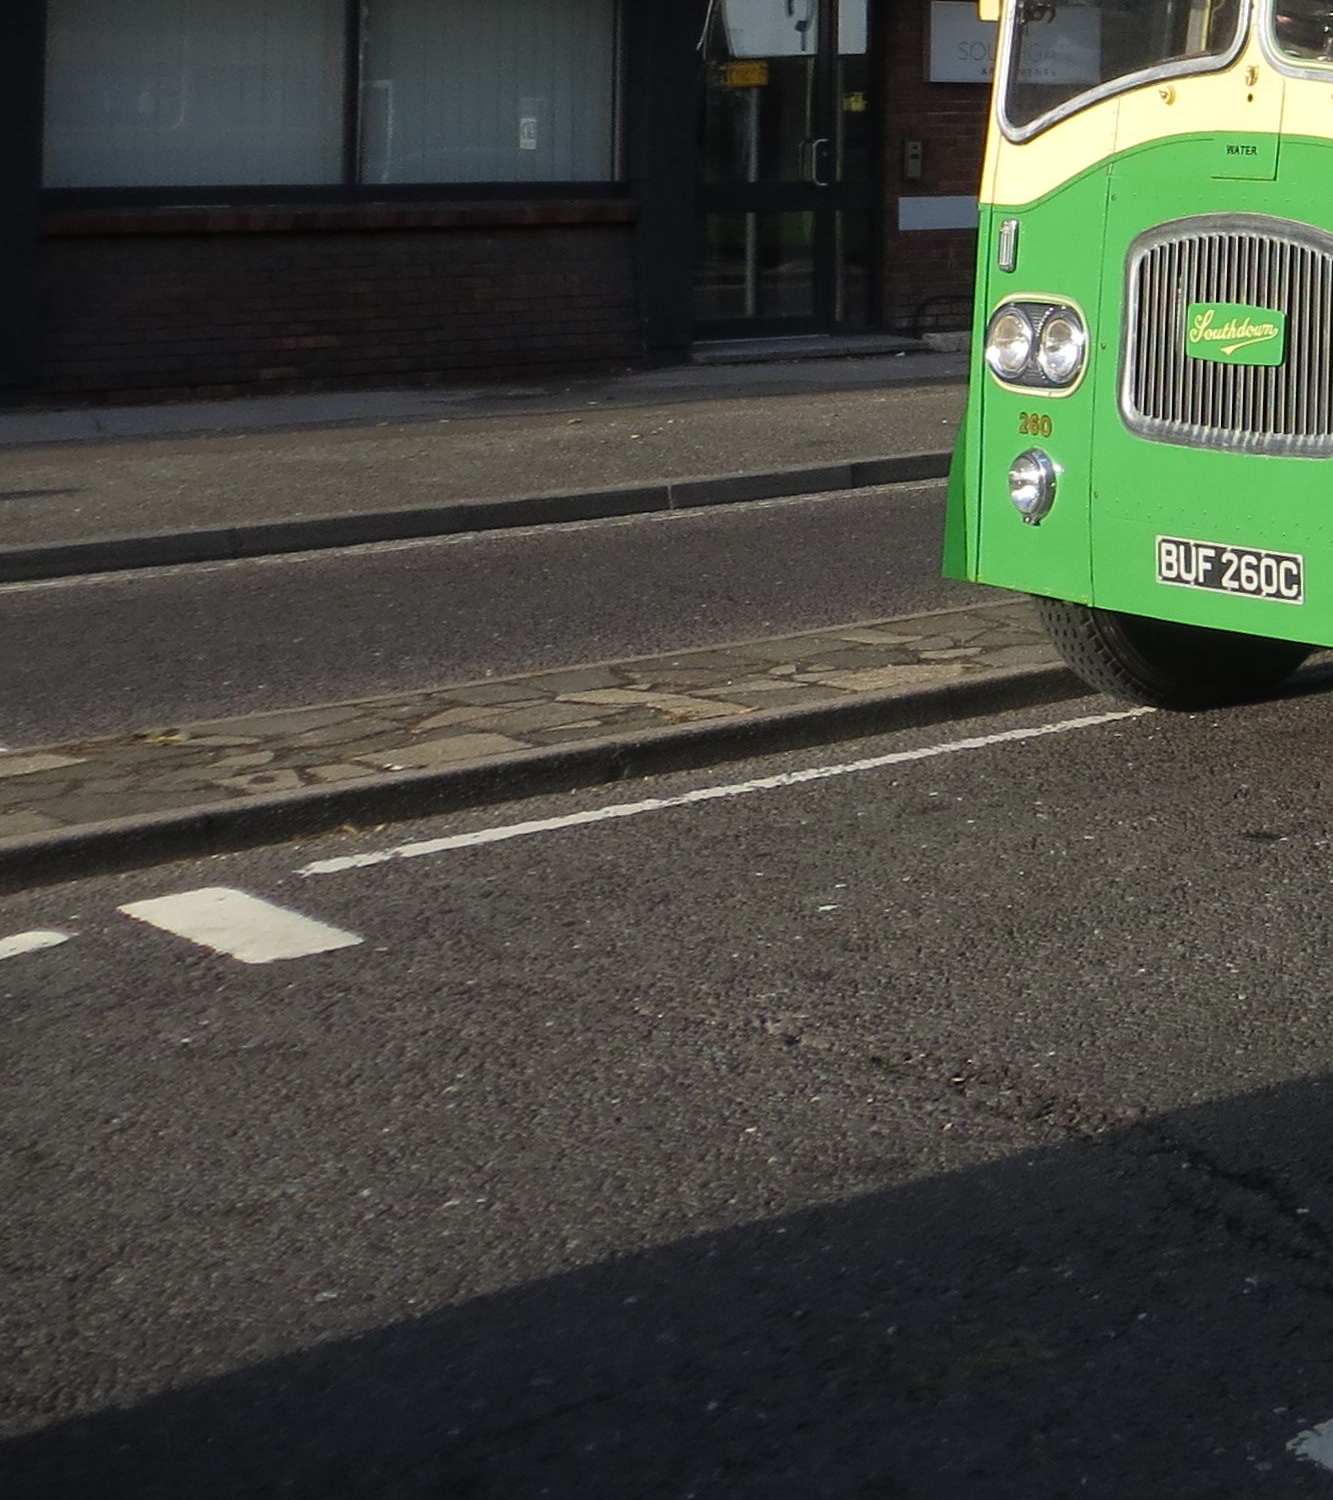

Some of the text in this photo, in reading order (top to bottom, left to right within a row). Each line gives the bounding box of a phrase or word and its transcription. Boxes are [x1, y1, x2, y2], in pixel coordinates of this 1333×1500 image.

[1226, 145, 1258, 156] WATER
[1190, 309, 1280, 346] Southdown
[1019, 411, 1054, 438] 260
[1160, 542, 1299, 597] BUF 260C
